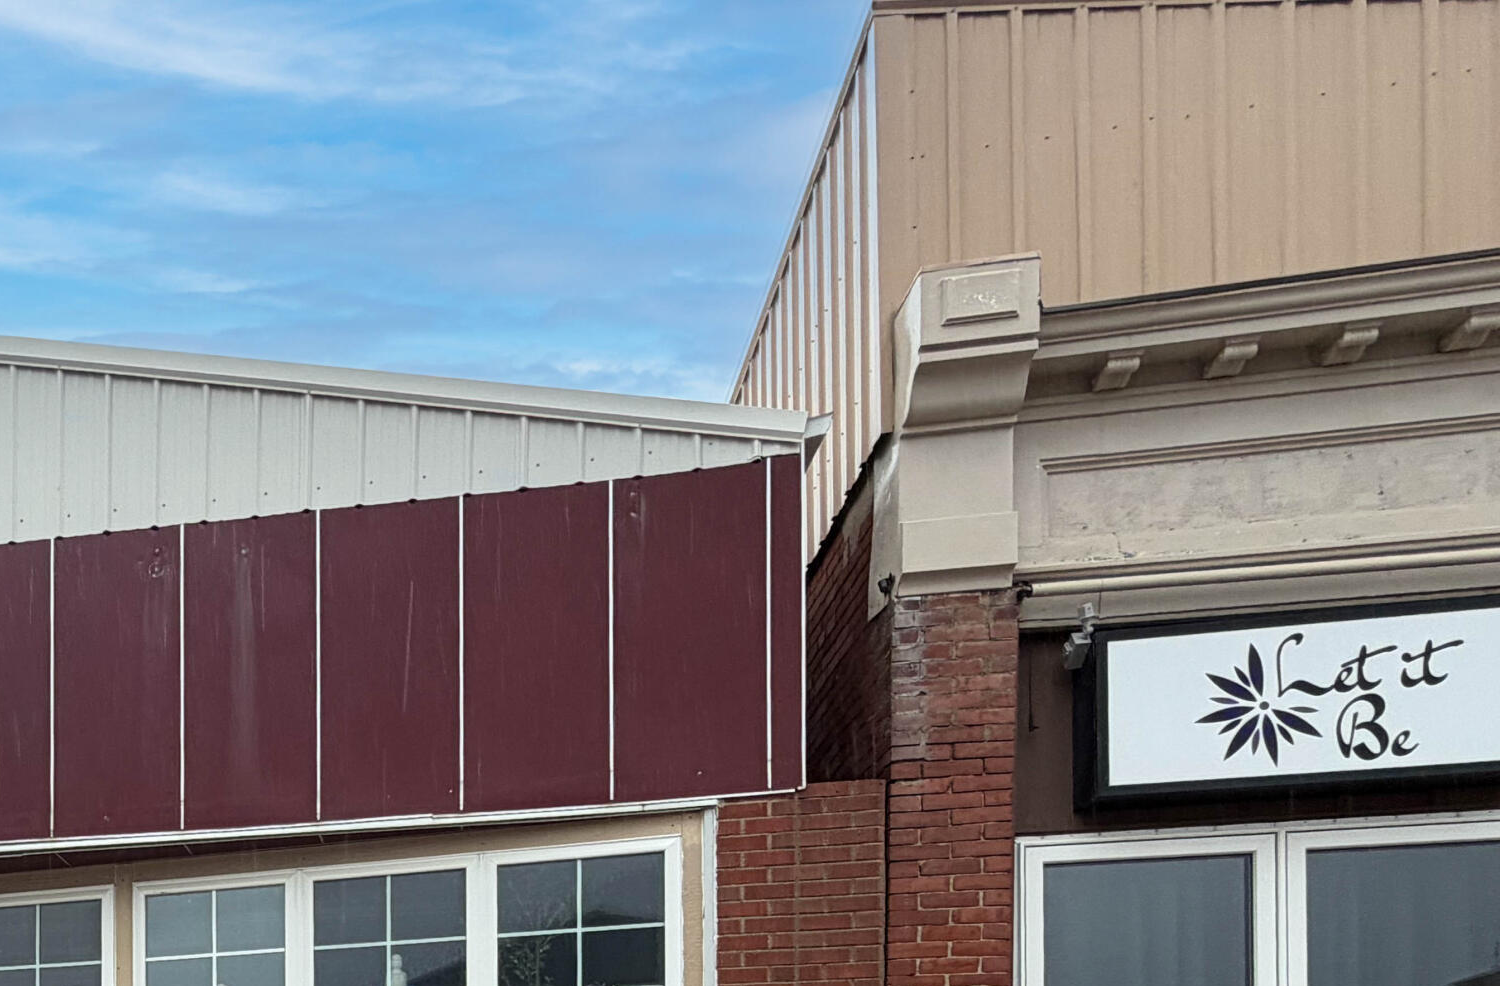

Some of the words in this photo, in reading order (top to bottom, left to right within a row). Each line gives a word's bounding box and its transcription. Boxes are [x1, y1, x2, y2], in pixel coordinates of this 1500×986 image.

[1277, 632, 1398, 697] Let
[1401, 639, 1465, 688] it
[1336, 693, 1420, 761] Be
